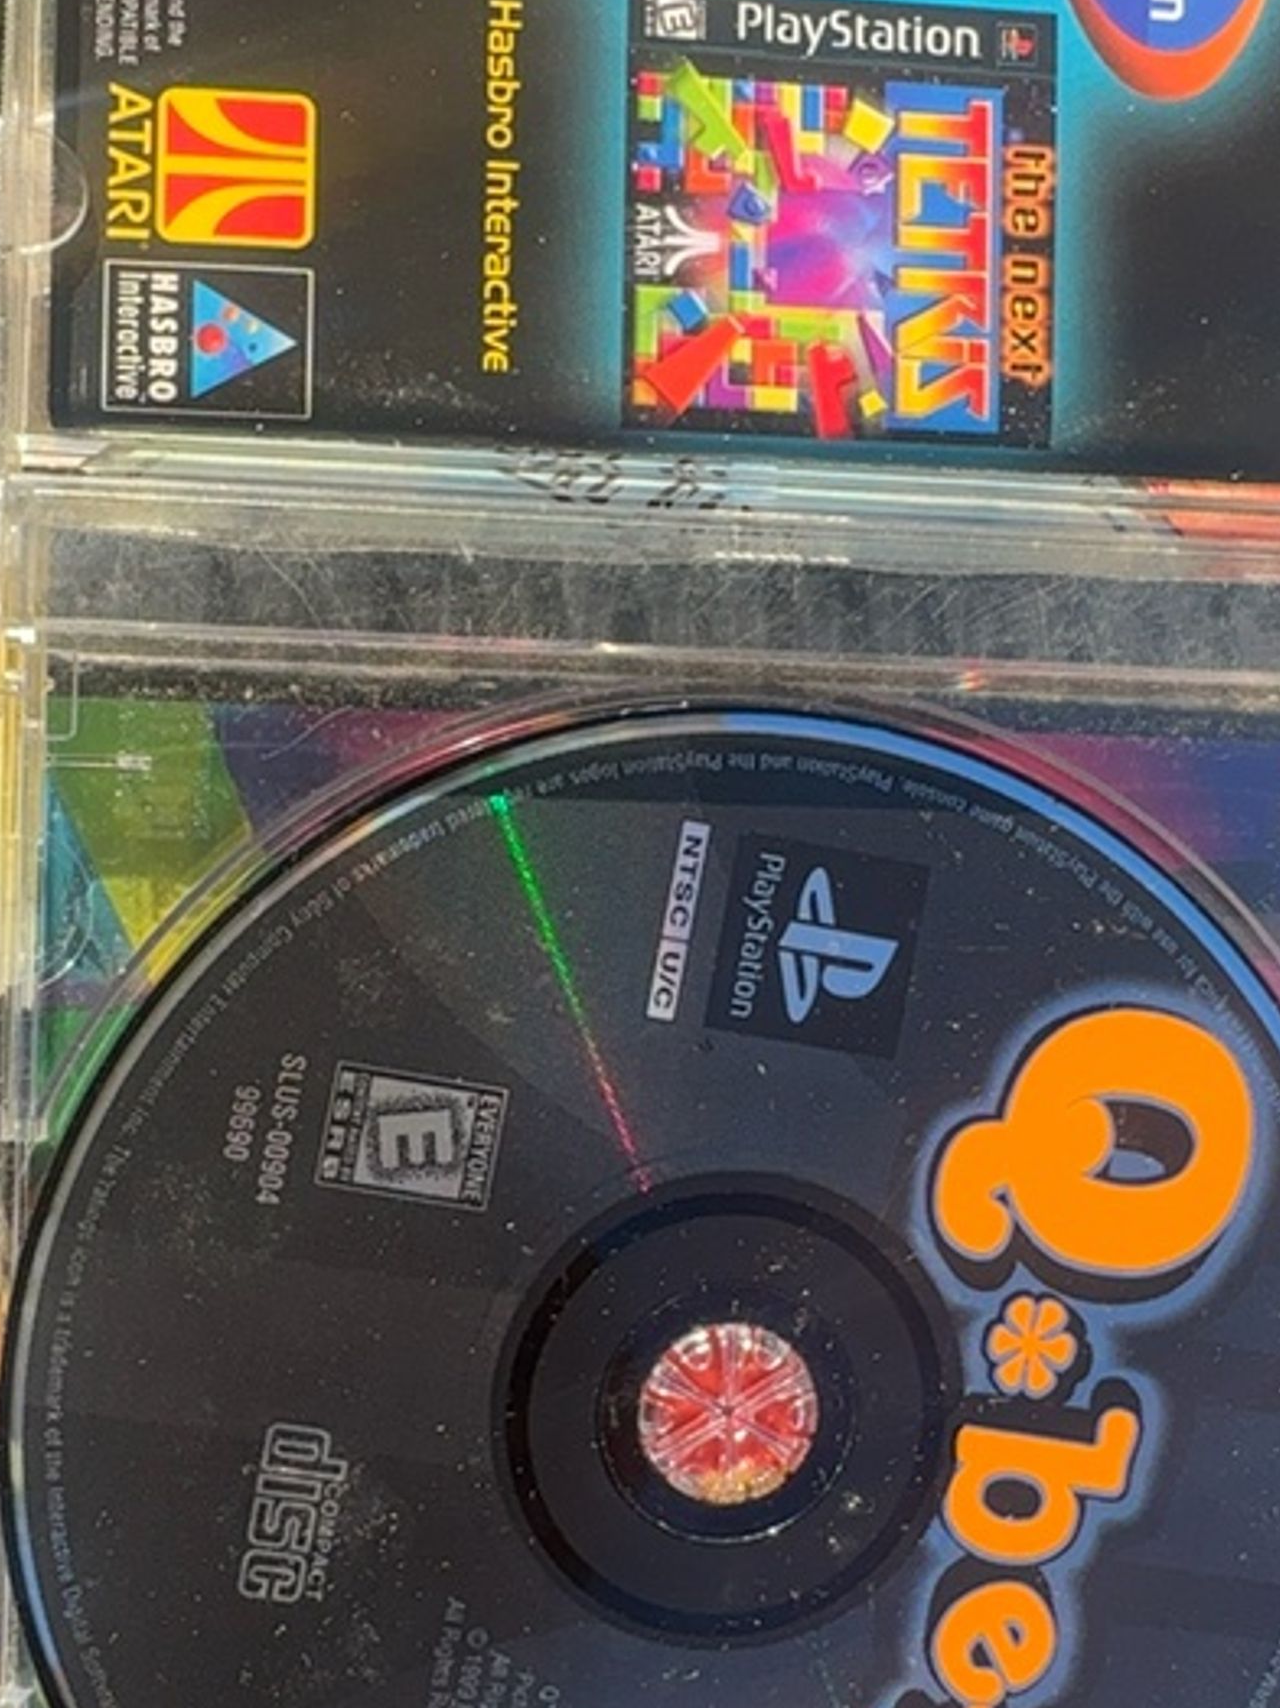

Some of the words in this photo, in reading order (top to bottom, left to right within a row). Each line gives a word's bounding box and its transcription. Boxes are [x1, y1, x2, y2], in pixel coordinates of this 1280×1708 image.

[735, 2, 982, 58] PlayStation
[107, 82, 152, 240] ATARI
[1010, 147, 1049, 235] the
[481, 160, 520, 372] Interactive
[634, 203, 661, 277] ATARI
[115, 272, 145, 400] Interactive
[148, 273, 178, 401] HASBRO
[1009, 259, 1046, 383] next
[668, 833, 704, 929] NTSC
[729, 853, 785, 1018] PlayStation
[652, 951, 681, 1011] U/C
[222, 1085, 260, 1162] 99690
[255, 1053, 307, 1206] SLUS-00904
[377, 1108, 454, 1169] E
[461, 1094, 501, 1202] EVERYONE
[237, 1422, 349, 1603] disc
[305, 1482, 344, 1602] COMPACT
